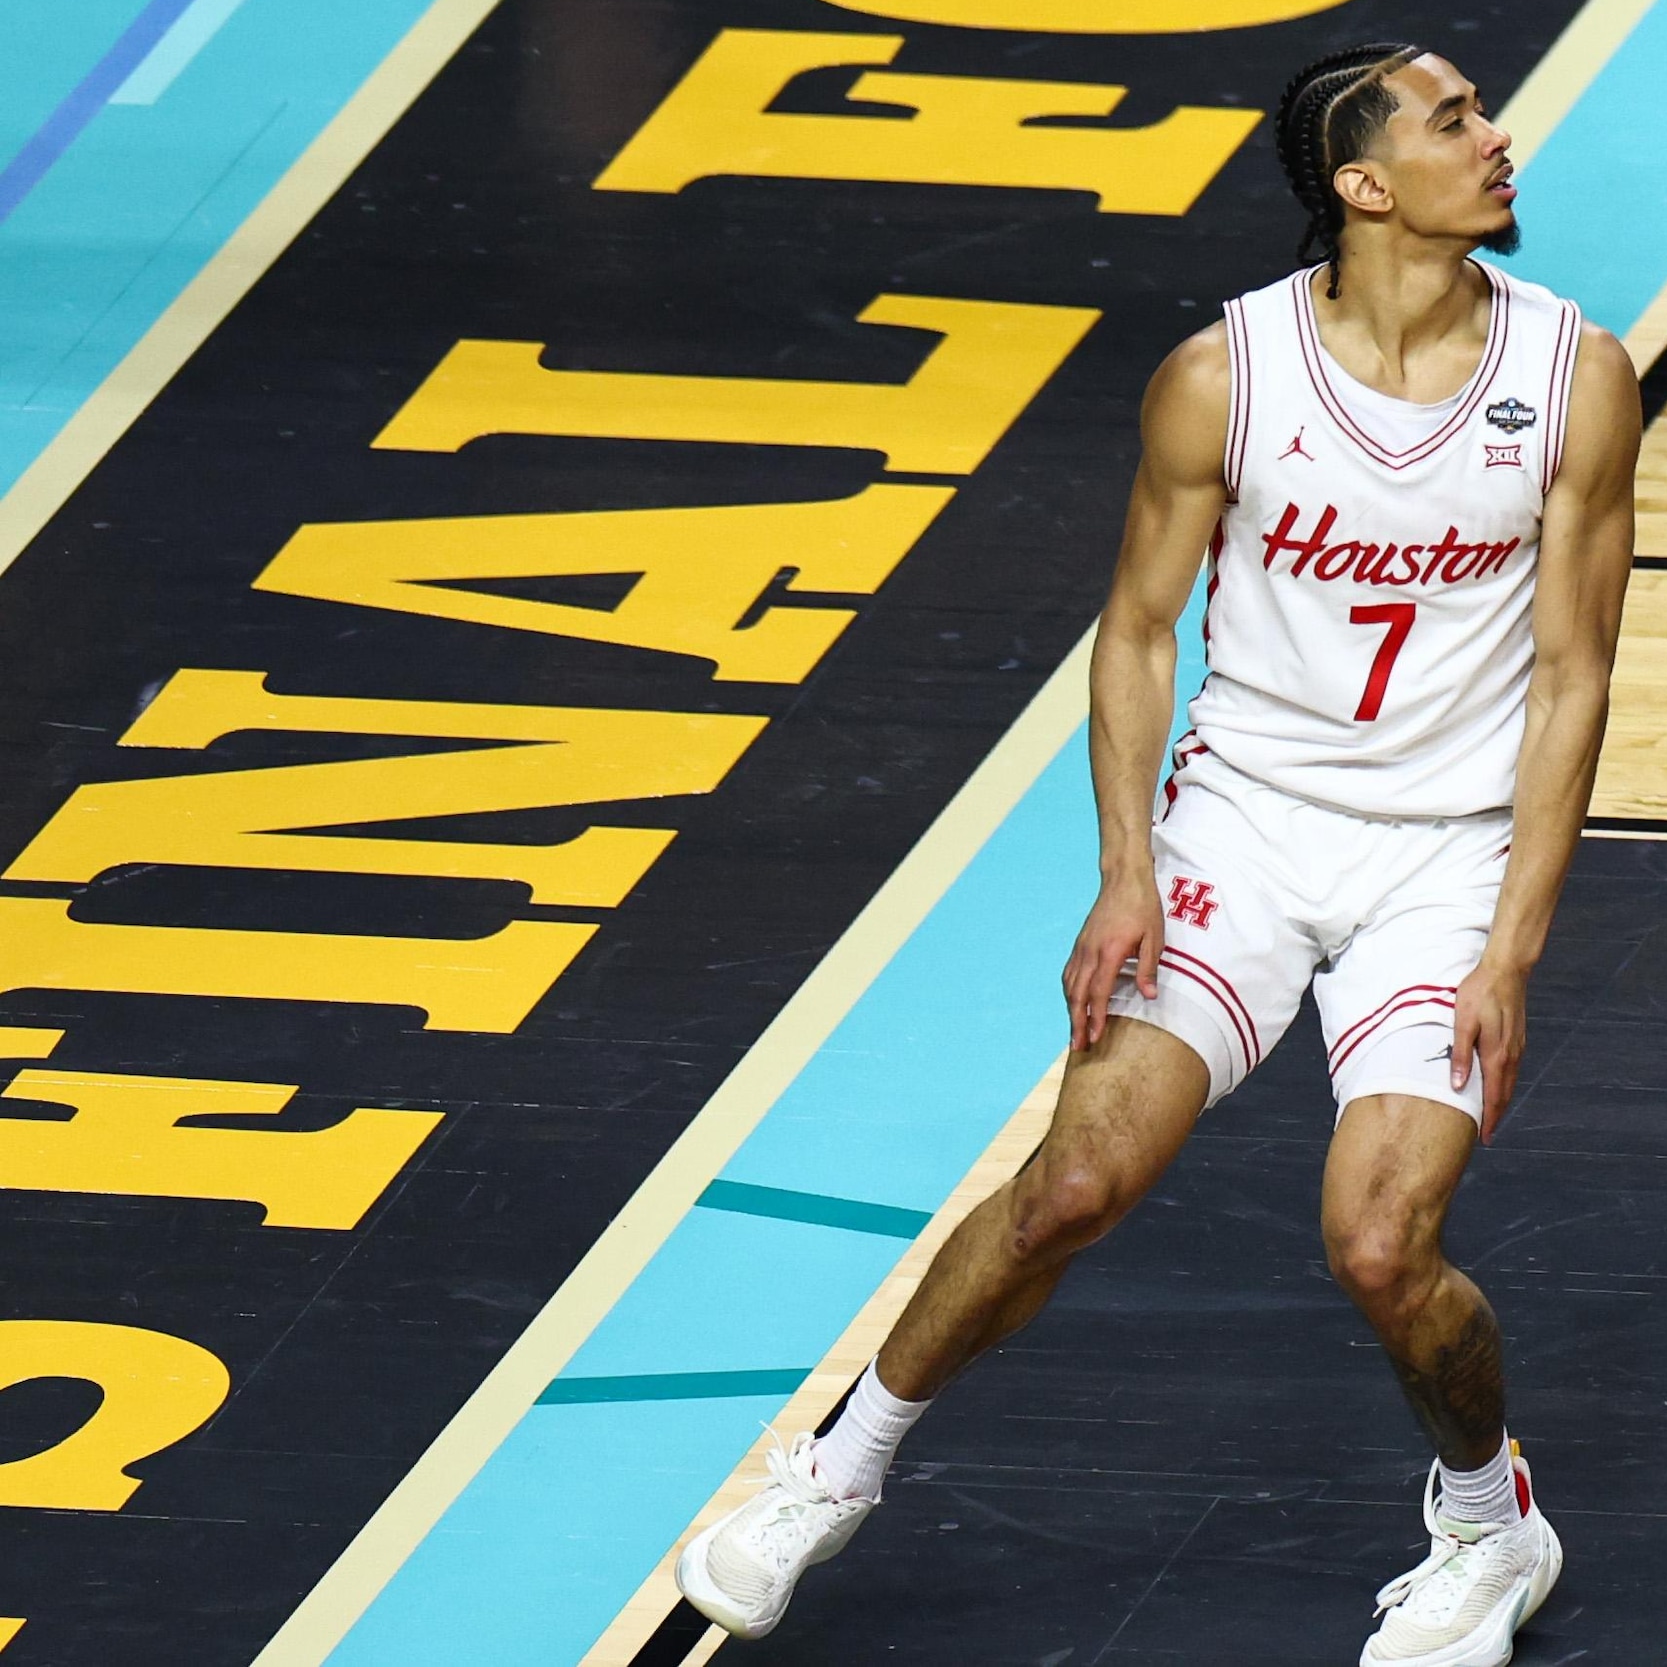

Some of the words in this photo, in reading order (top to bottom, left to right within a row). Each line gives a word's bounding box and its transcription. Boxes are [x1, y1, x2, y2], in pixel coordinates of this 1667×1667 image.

[1488, 408, 1512, 420] FINAL
[1511, 409, 1536, 421] FOUR
[1262, 501, 1521, 587] Houston
[1350, 602, 1417, 722] 7
